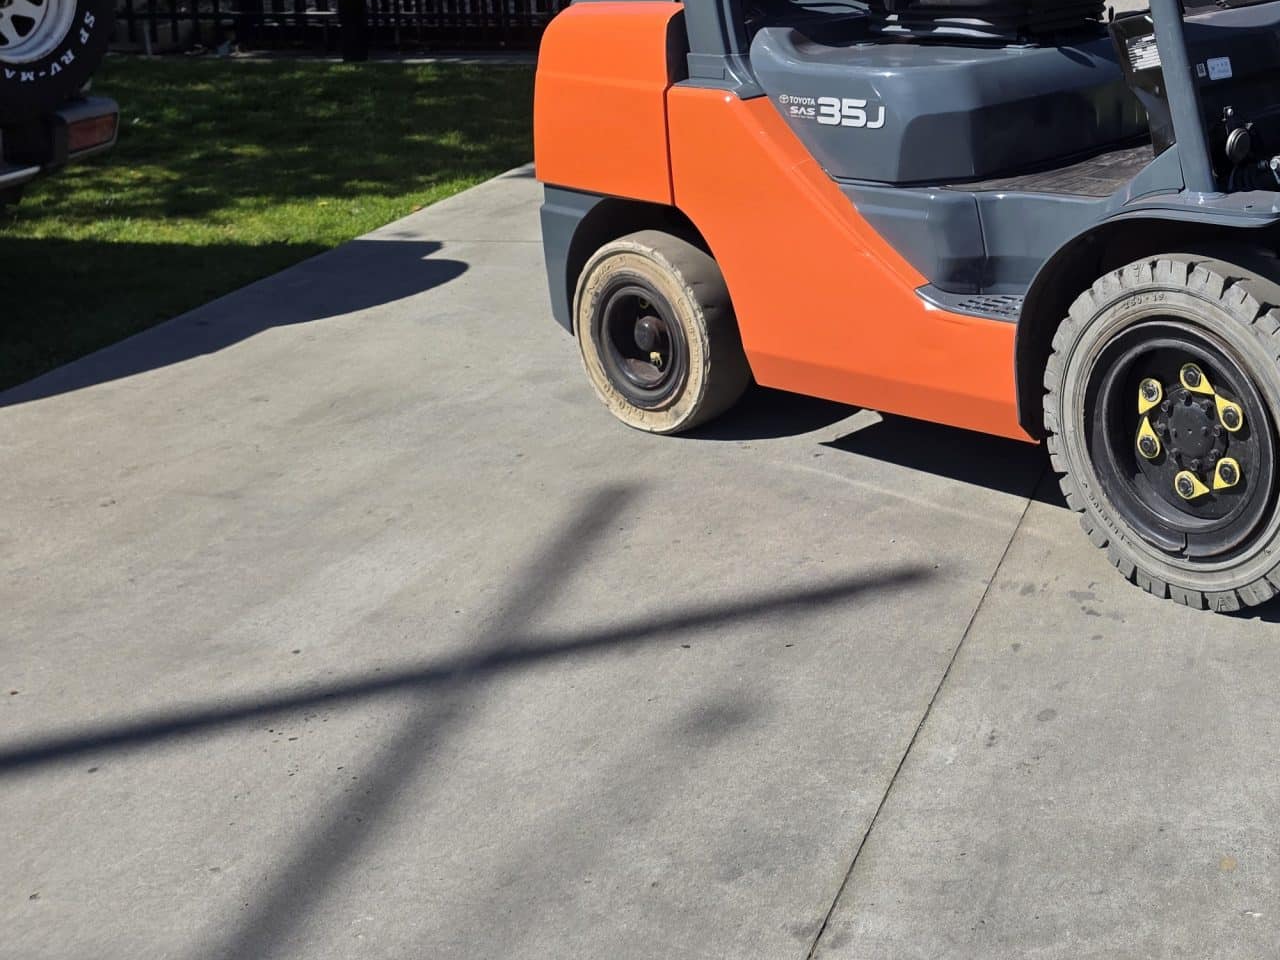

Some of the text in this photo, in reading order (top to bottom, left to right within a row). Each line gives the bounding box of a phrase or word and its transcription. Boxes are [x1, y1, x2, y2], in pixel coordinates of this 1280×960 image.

[789, 95, 816, 106] TOYOTA
[789, 105, 816, 116] SAS
[816, 96, 886, 129] 35J
